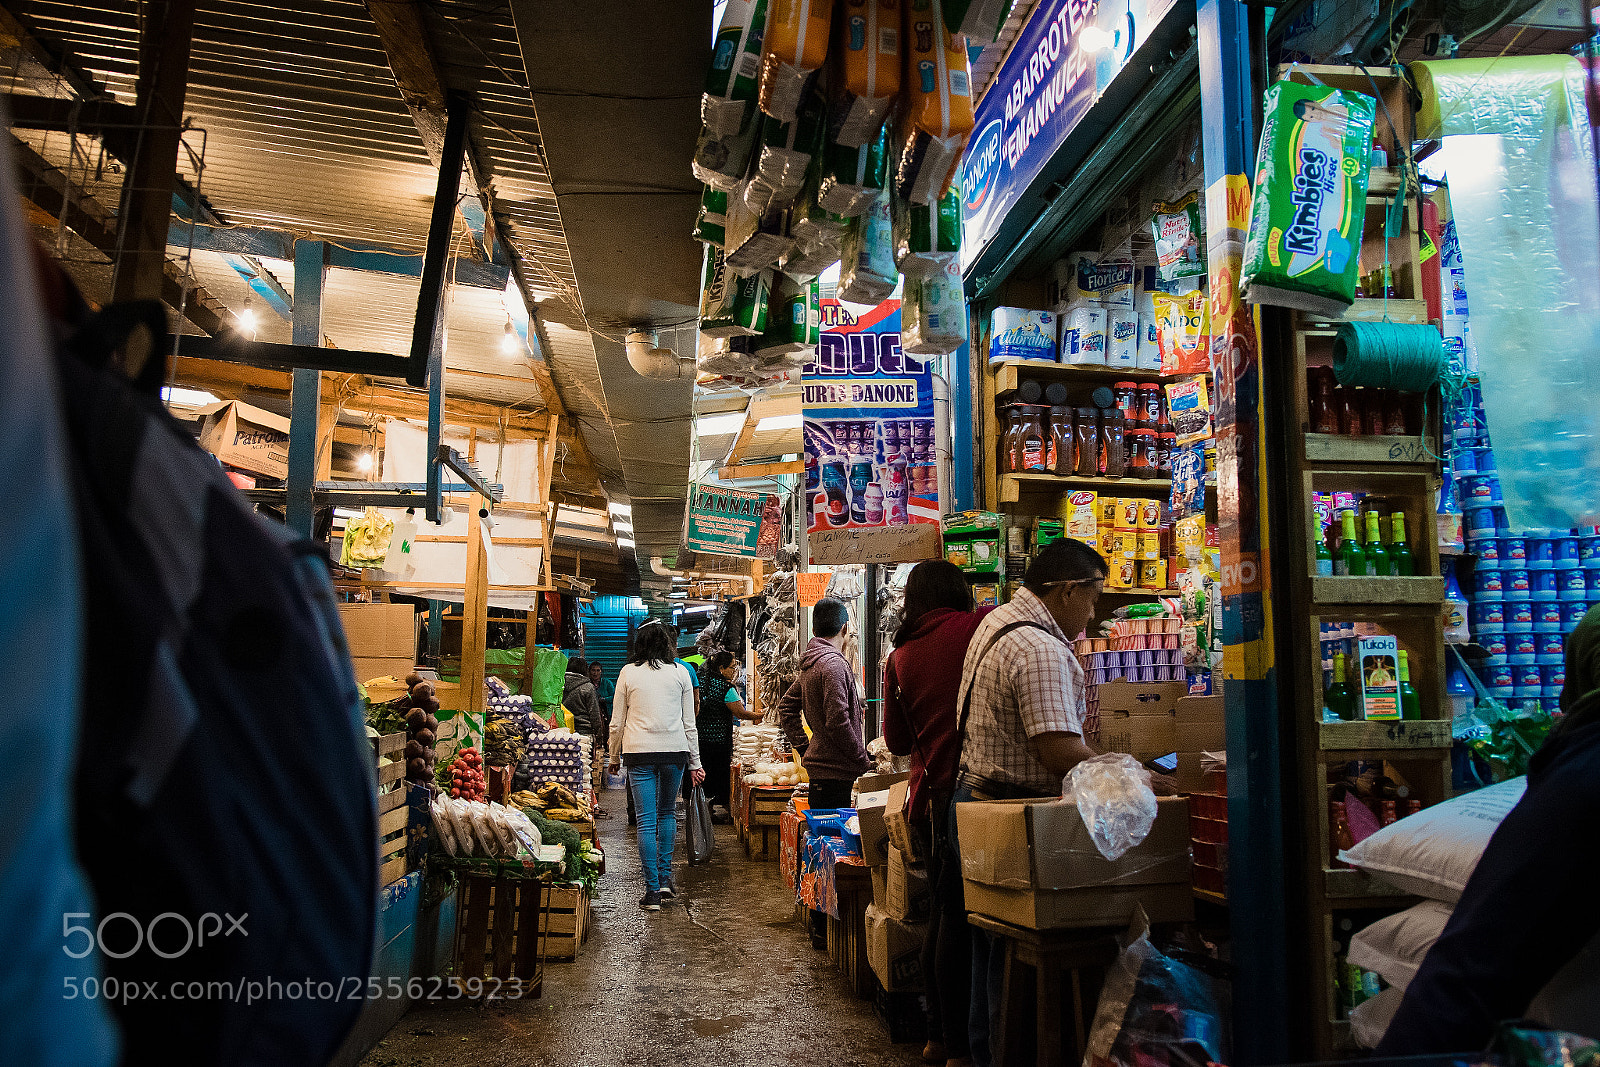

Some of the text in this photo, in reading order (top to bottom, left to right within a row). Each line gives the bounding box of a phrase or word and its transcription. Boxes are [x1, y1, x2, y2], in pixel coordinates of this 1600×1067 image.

[1324, 157, 1338, 194] Hi-sec
[1343, 159, 1356, 176] 40
[1284, 148, 1327, 256] Kimbies
[1270, 230, 1280, 264] NUEVO
[1088, 269, 1126, 289] Floricel
[999, 328, 1052, 349] Adorable
[852, 384, 915, 403] DANONE
[690, 492, 766, 518] HANNAH
